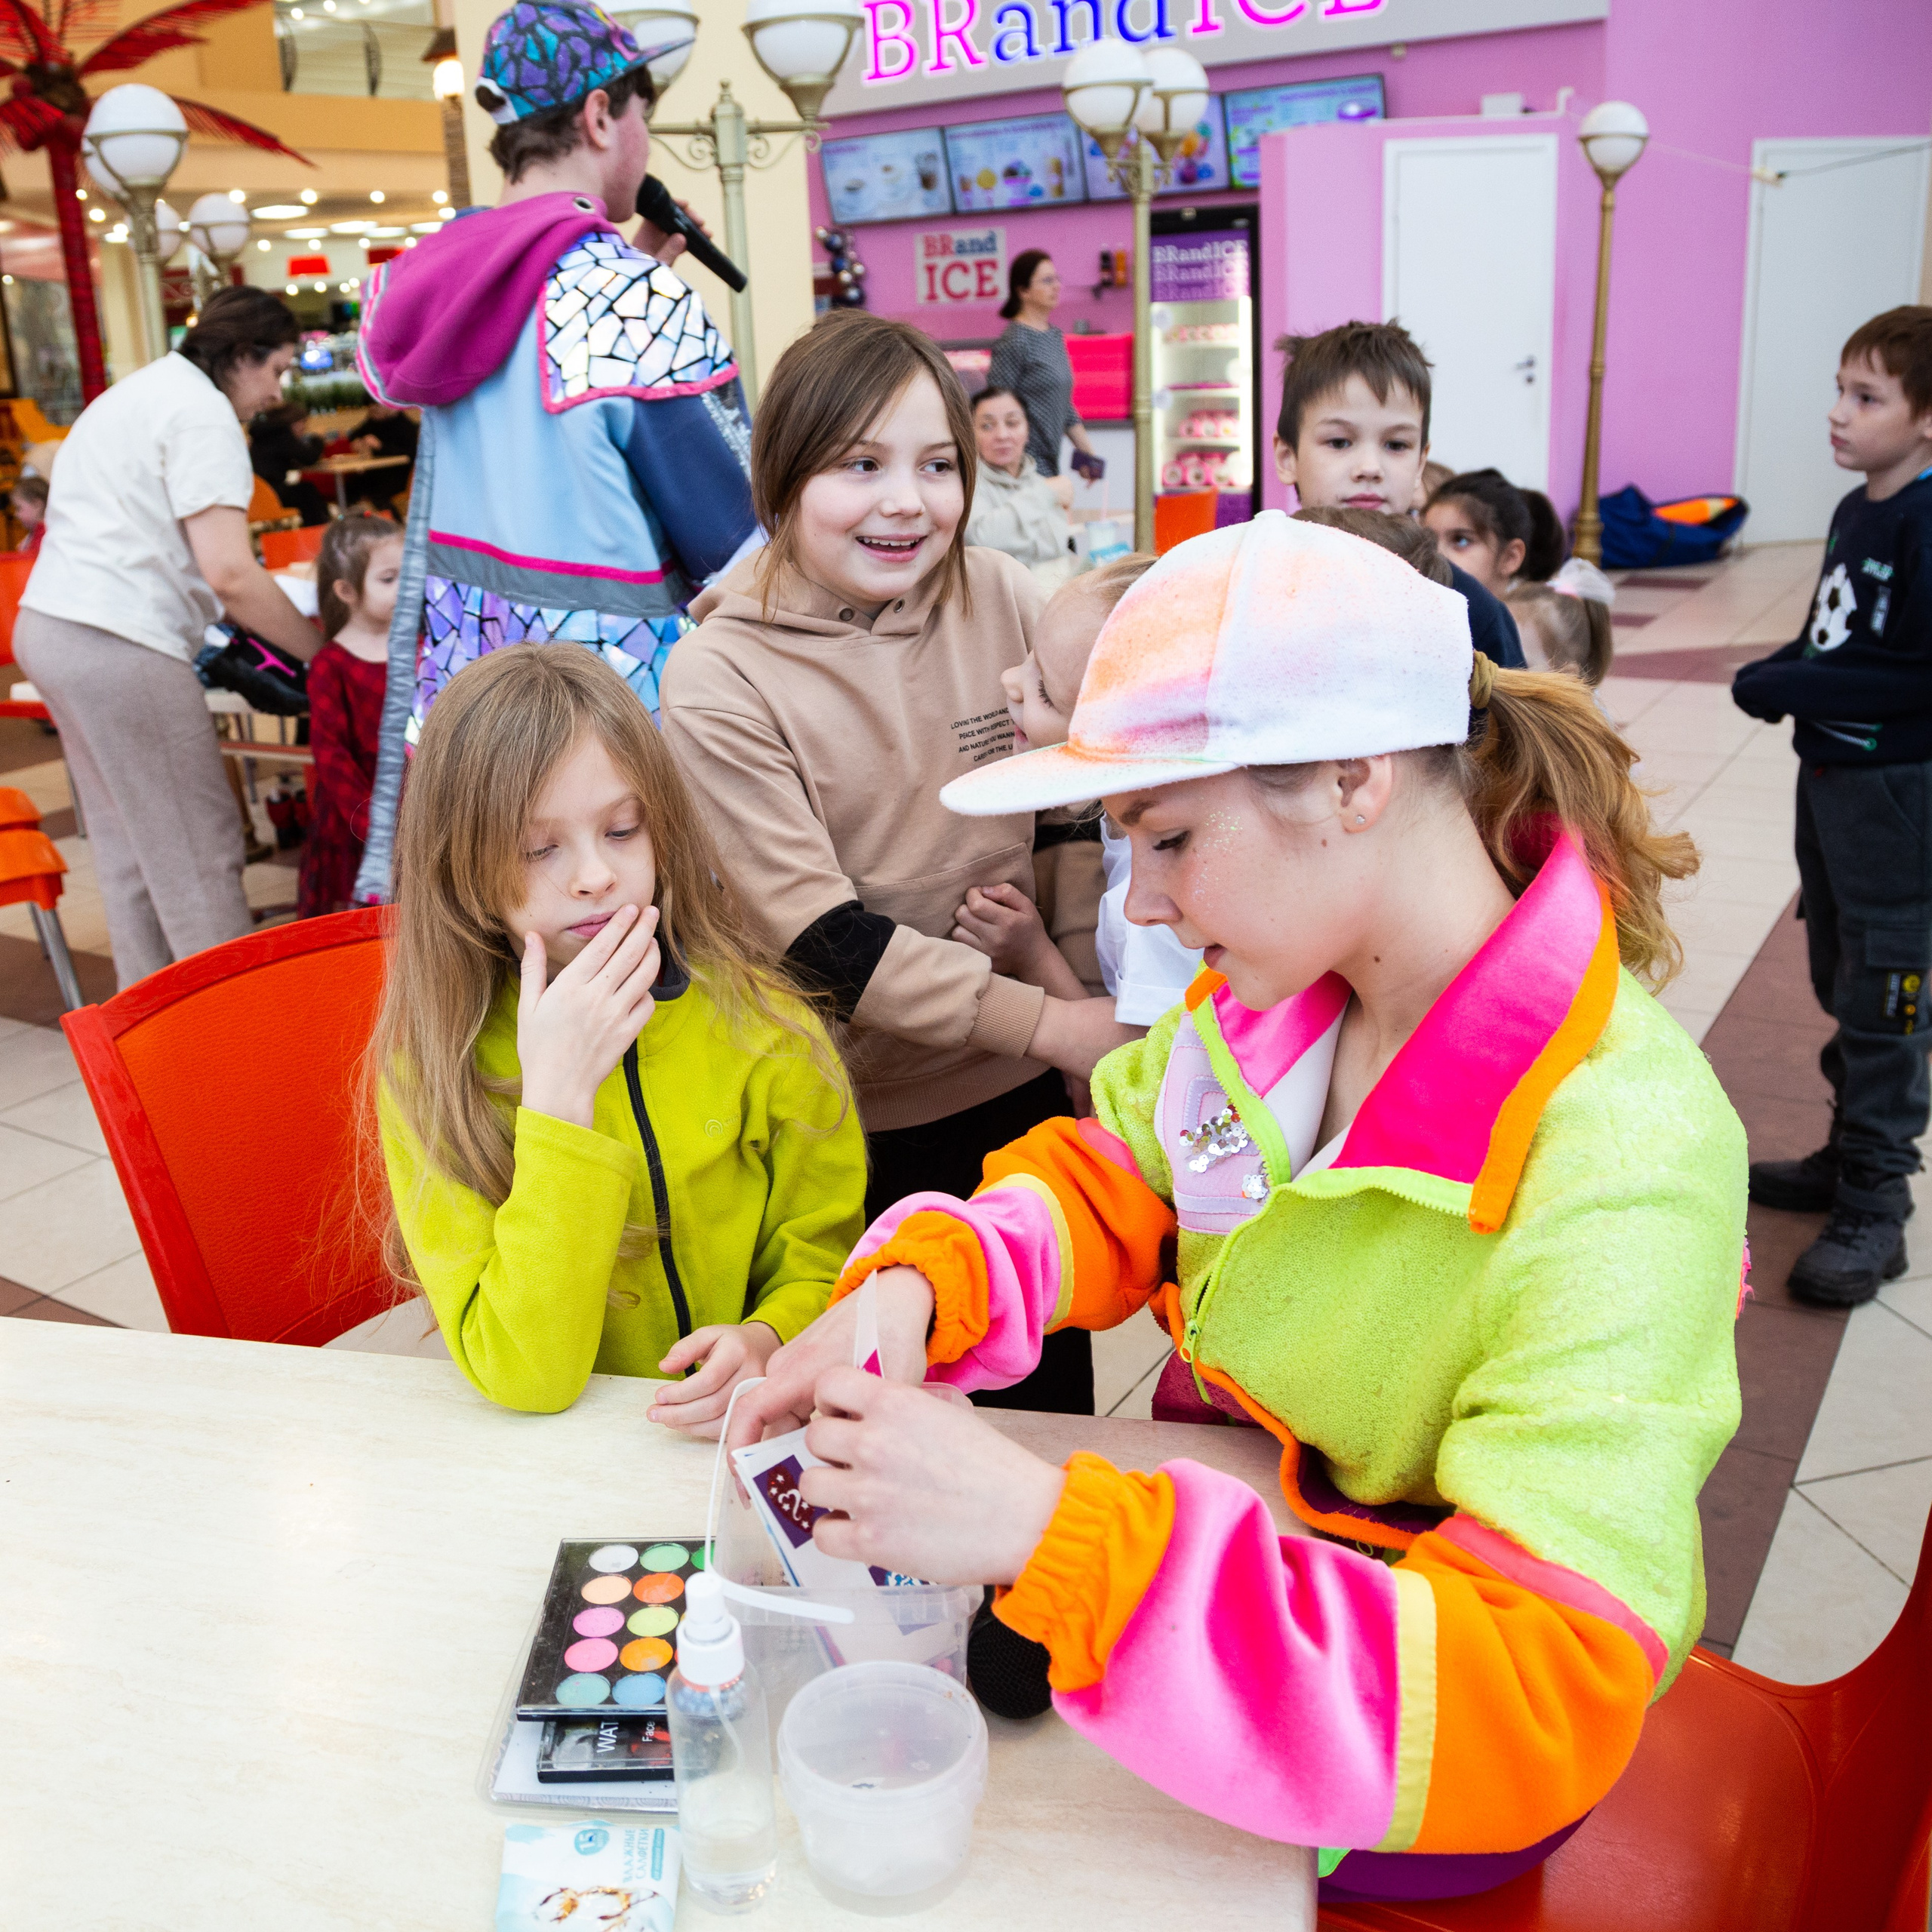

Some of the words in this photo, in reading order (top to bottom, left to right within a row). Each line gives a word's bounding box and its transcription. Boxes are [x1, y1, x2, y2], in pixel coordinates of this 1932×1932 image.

[924, 230, 997, 258] BRand
[924, 260, 999, 301] ICE
[970, 715, 983, 724] THE
[958, 731, 975, 740] PEACE
[958, 744, 970, 752] AND
[995, 744, 1008, 753] THE
[642, 1721, 655, 1742] Face
[622, 1829, 635, 1883] ВЛАЖНЫЕ
[635, 1829, 649, 1879] САЛФЕТКИ
